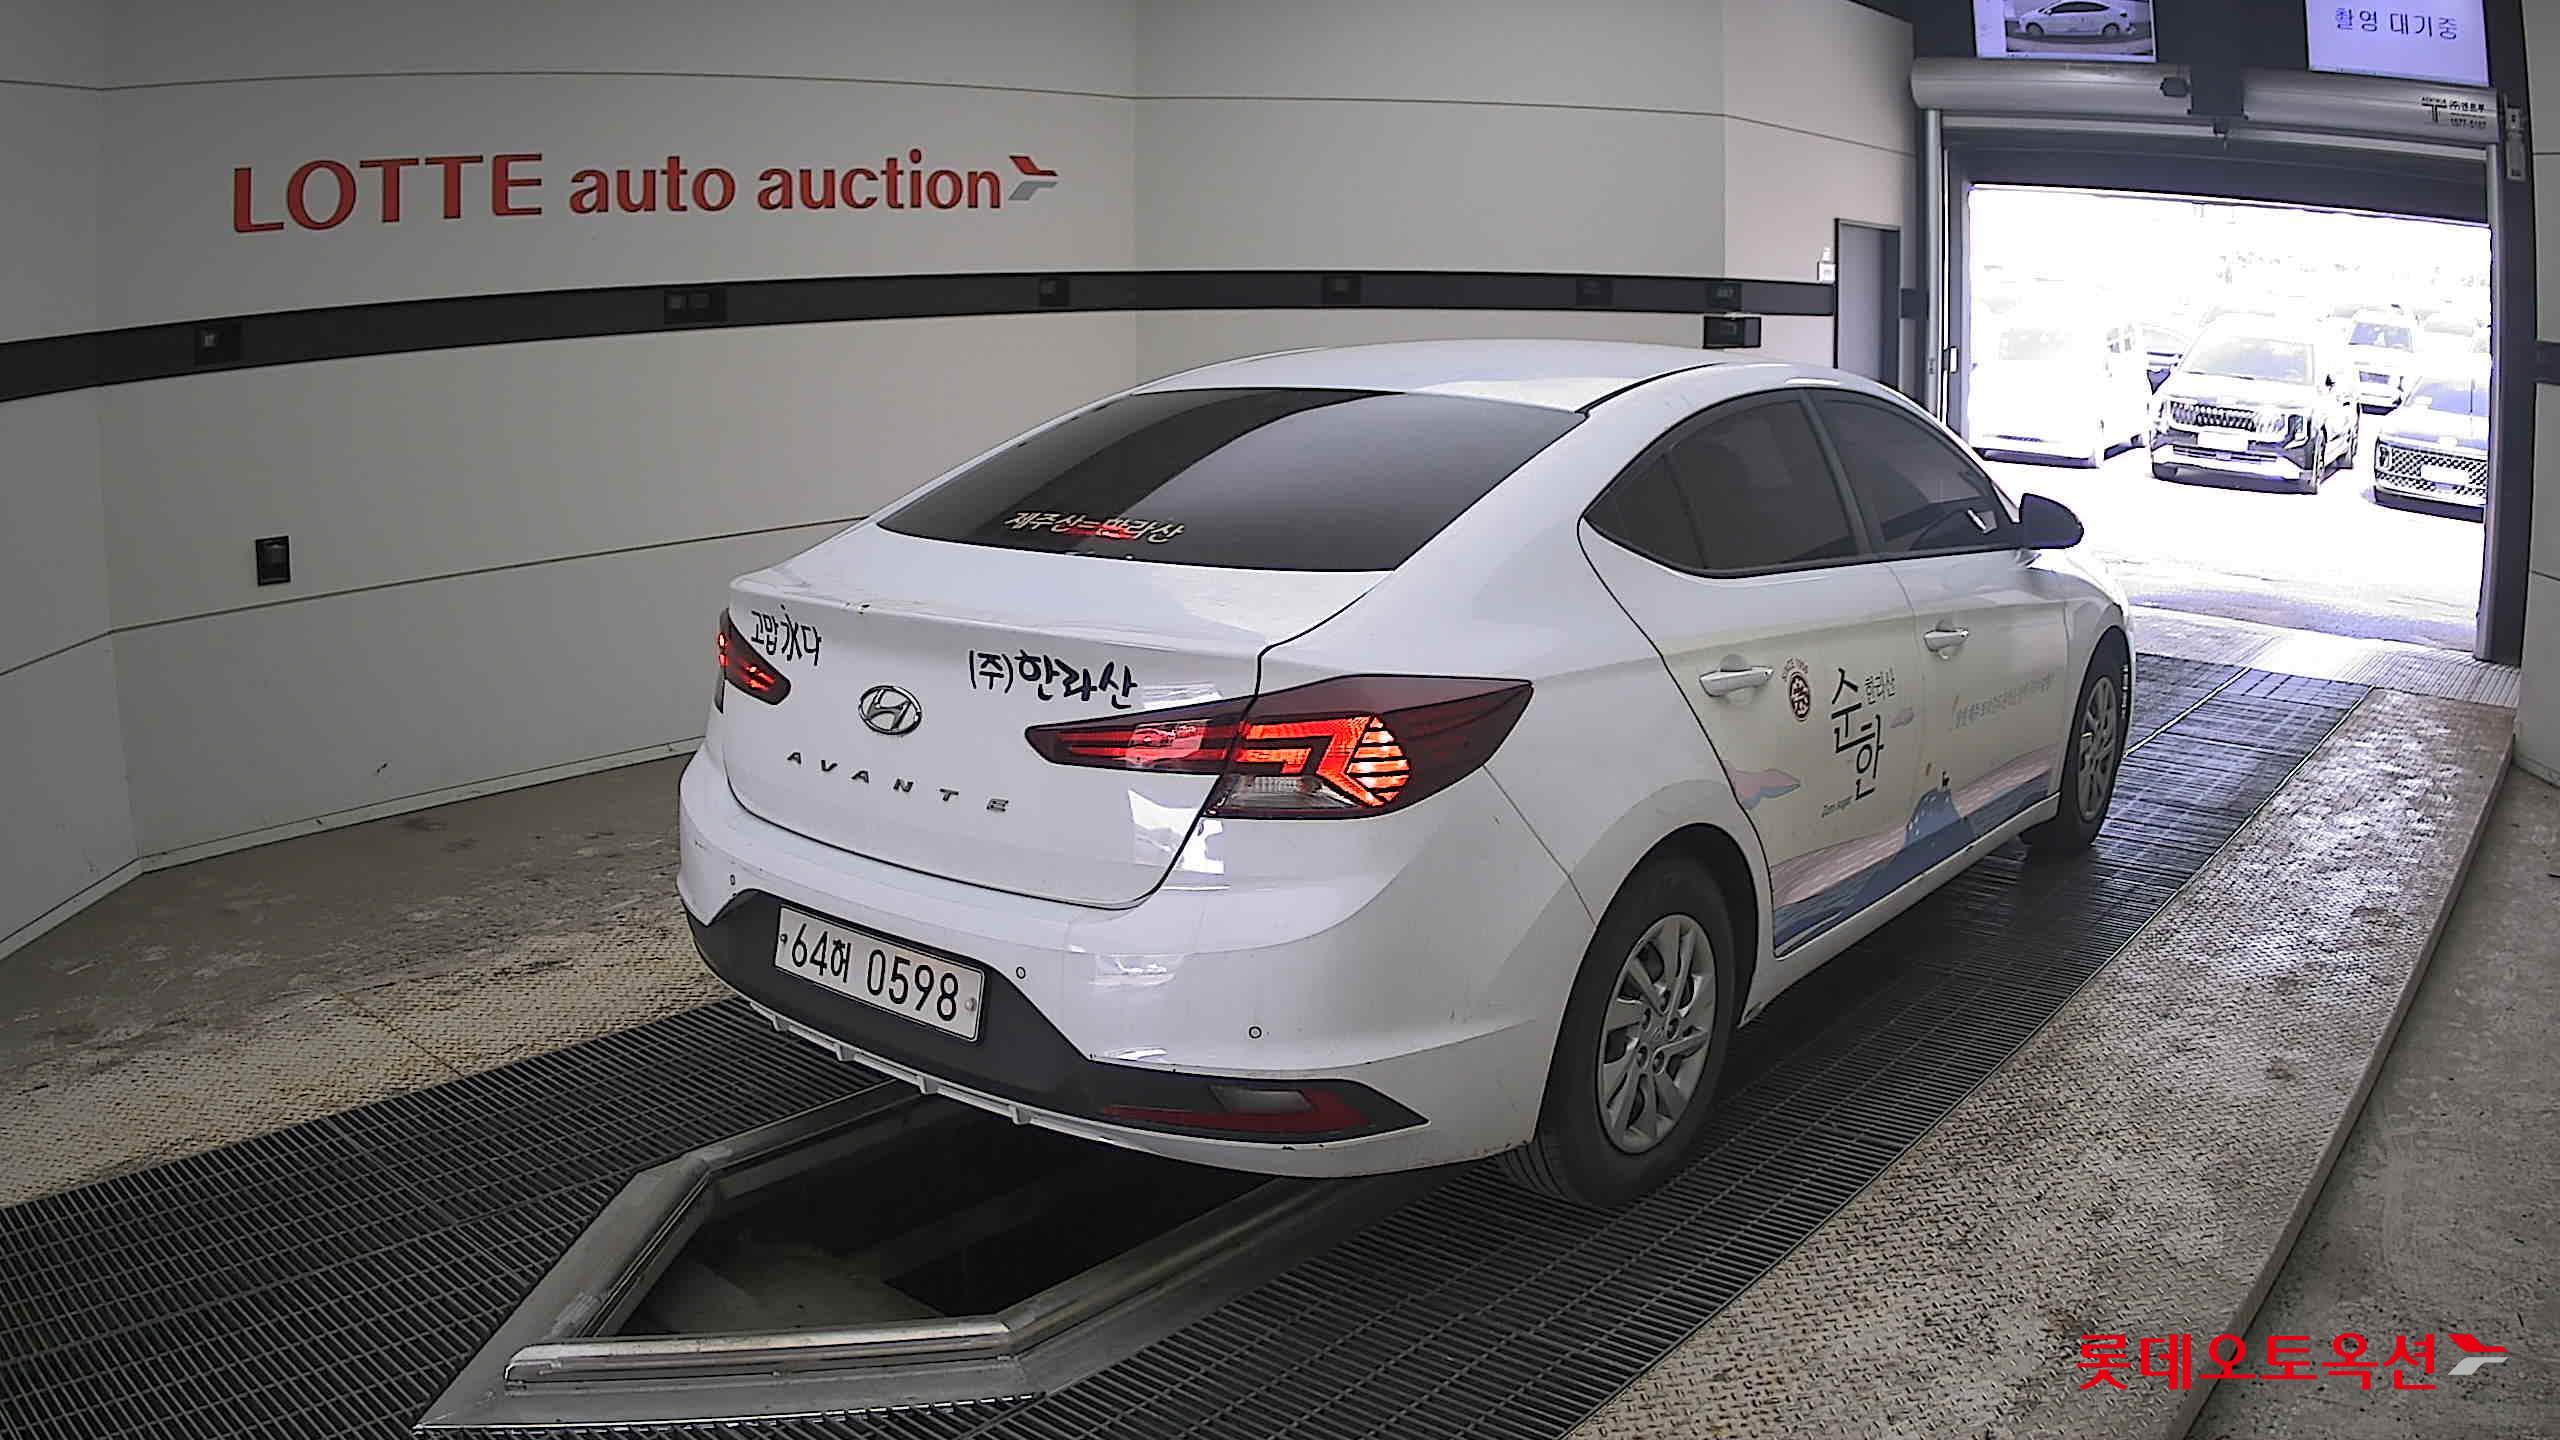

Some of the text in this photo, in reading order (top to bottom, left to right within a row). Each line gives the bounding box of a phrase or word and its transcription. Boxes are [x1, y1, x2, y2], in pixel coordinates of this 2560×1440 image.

[2390, 12, 2458, 41] 대기중
[233, 148, 1003, 233] LOTTE auto auction
[968, 649, 1138, 710] (주)한라산
[786, 751, 1011, 813] AVANTE
[791, 923, 960, 1022] 64허 0598
